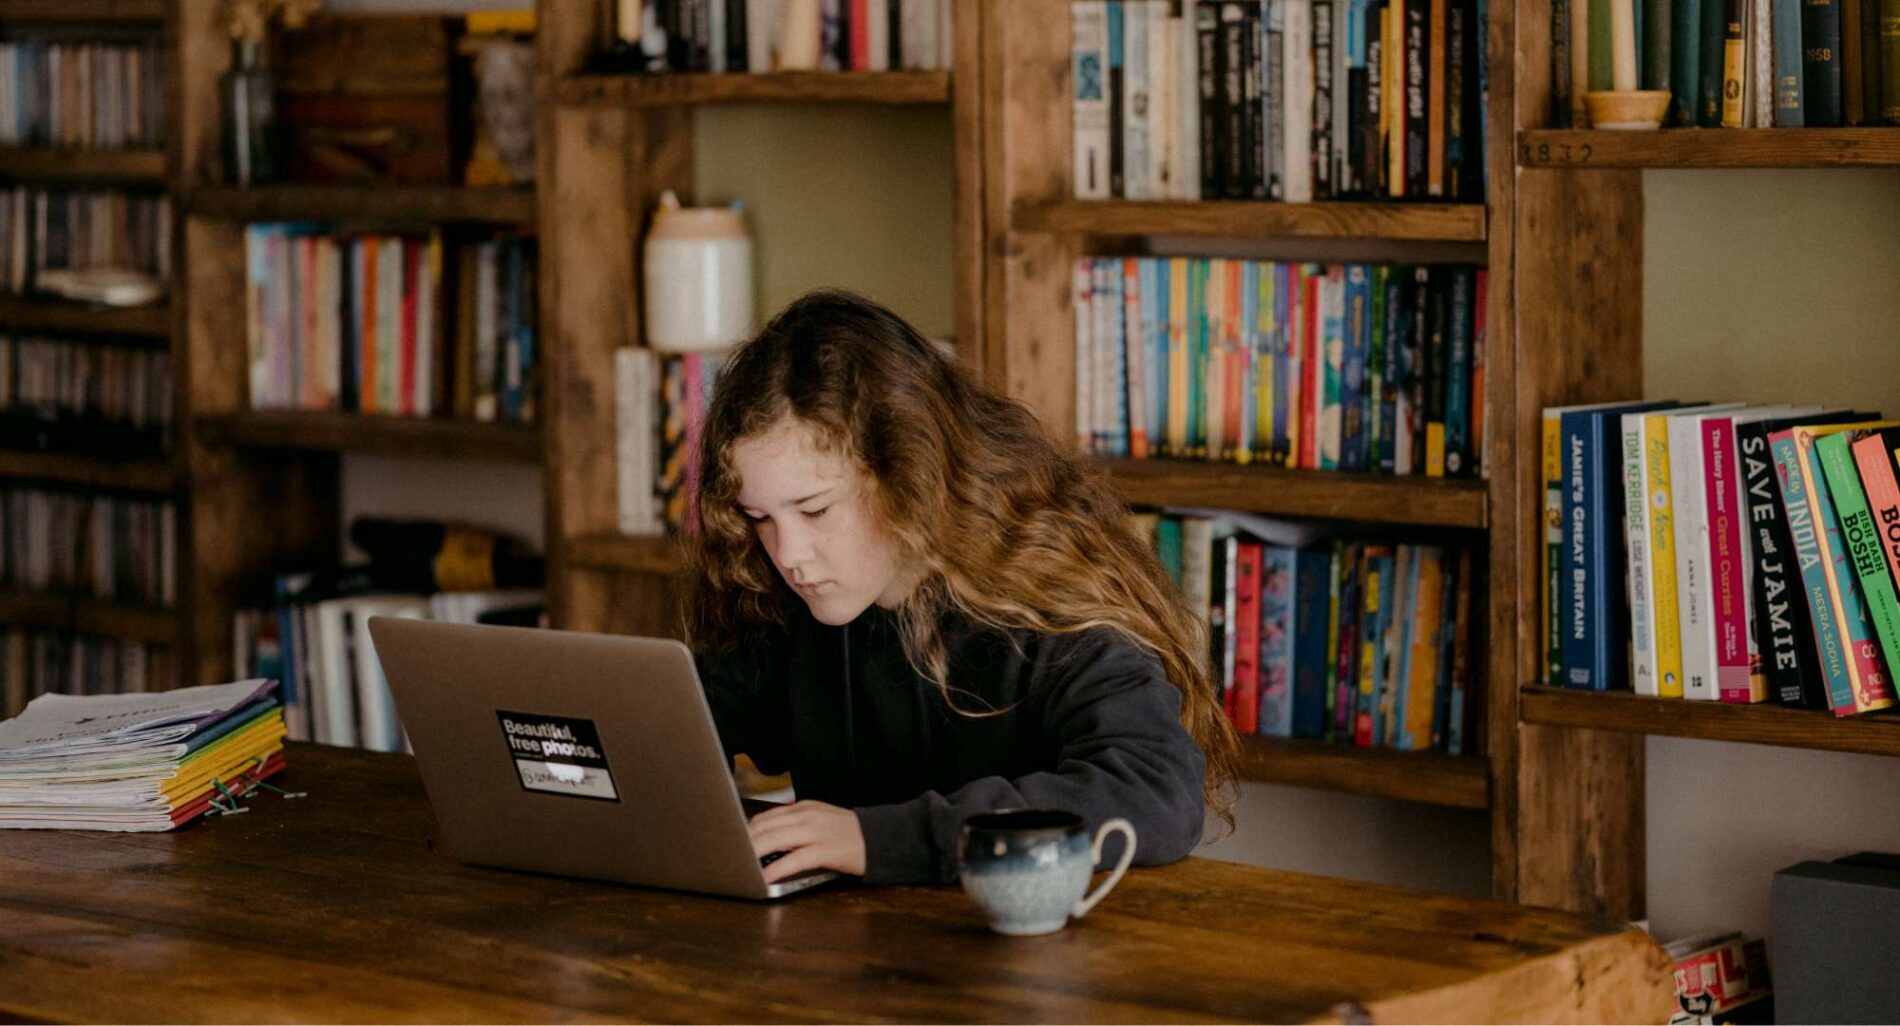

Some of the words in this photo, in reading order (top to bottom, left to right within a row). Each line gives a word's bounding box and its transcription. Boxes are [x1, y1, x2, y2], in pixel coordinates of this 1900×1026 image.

[1571, 433, 1585, 503] JAMIE'S
[1624, 431, 1640, 459] TOM
[1626, 463, 1644, 531] KERRIDGE
[1572, 506, 1586, 565] GREAT
[1717, 516, 1730, 556] Great
[1742, 436, 1776, 522] SAVE
[1761, 558, 1797, 671] JAMIE
[1787, 499, 1820, 571] INDIA
[1843, 512, 1876, 577] BOSH!
[1858, 509, 1875, 538] BISH
[1869, 540, 1885, 572] BASH
[1573, 568, 1587, 639] BRITAIN
[1687, 559, 1695, 588] ANNA
[1720, 560, 1734, 616] Curries
[1812, 586, 1831, 631] MEERA
[1824, 634, 1842, 678] SODHA
[508, 735, 541, 752] free
[541, 739, 601, 760] photos.
